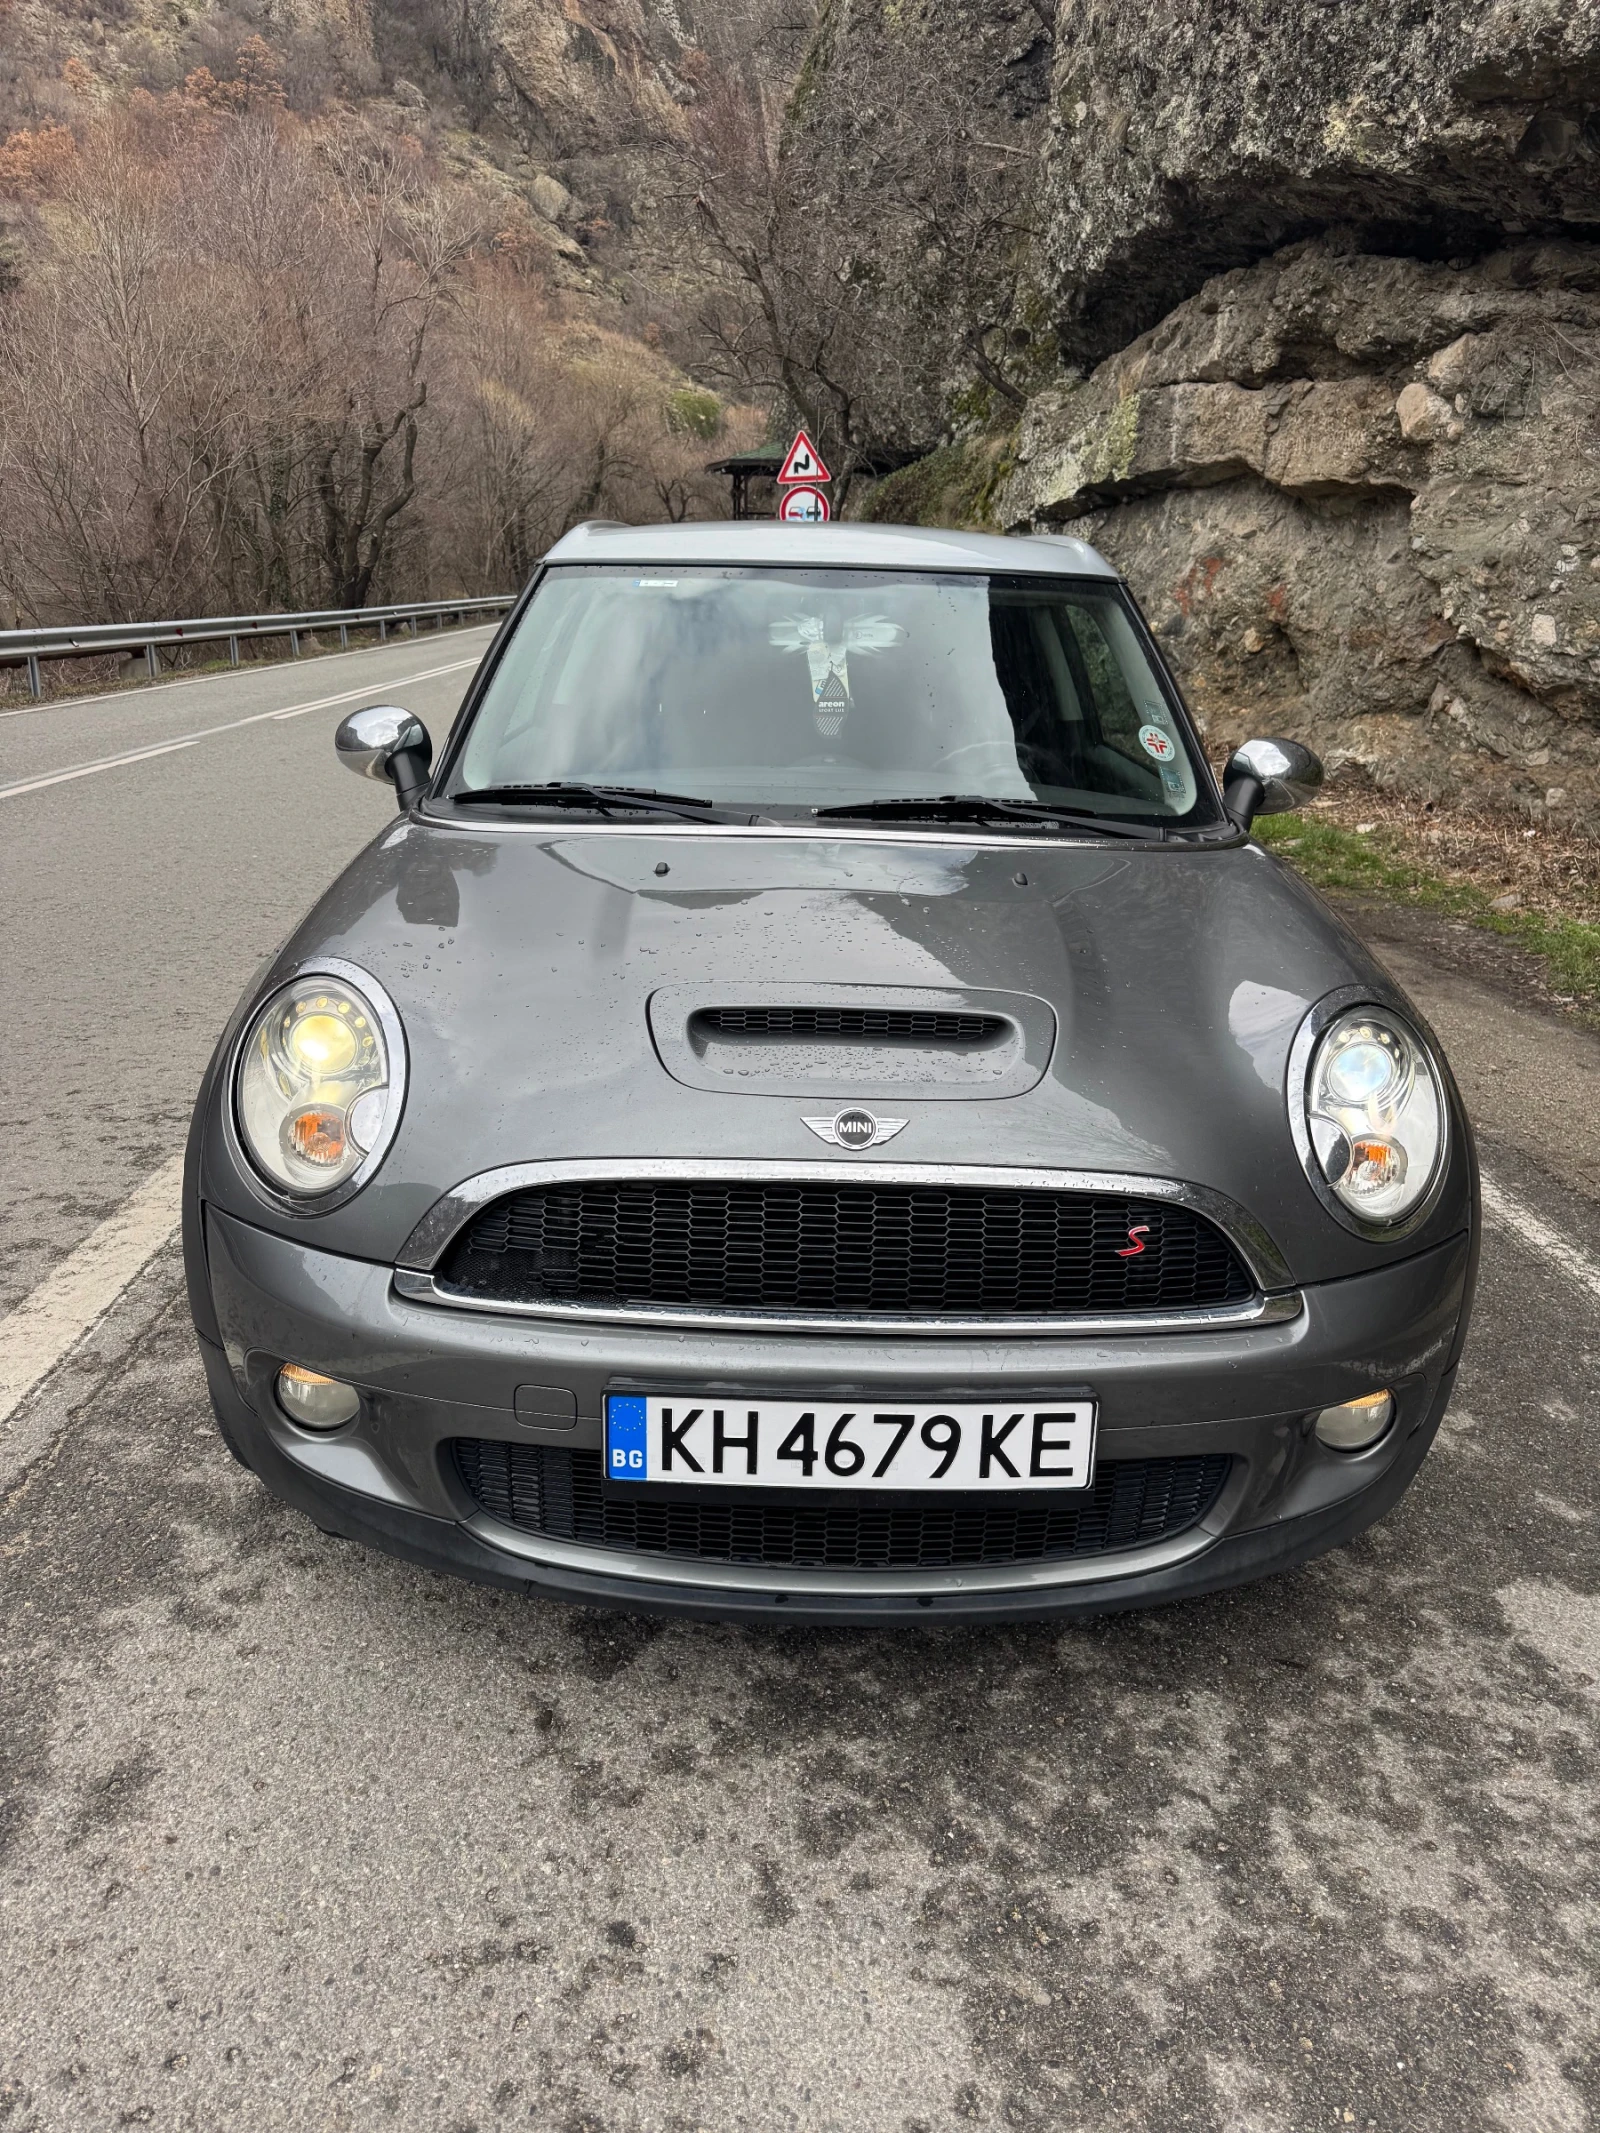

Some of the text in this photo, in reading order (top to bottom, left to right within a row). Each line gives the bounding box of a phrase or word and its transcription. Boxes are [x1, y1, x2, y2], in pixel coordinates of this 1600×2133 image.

[839, 1121, 872, 1134] MINI
[1114, 1225, 1150, 1257] S
[661, 1408, 1076, 1478] KH 4679 KE
[612, 1448, 643, 1468] BG
